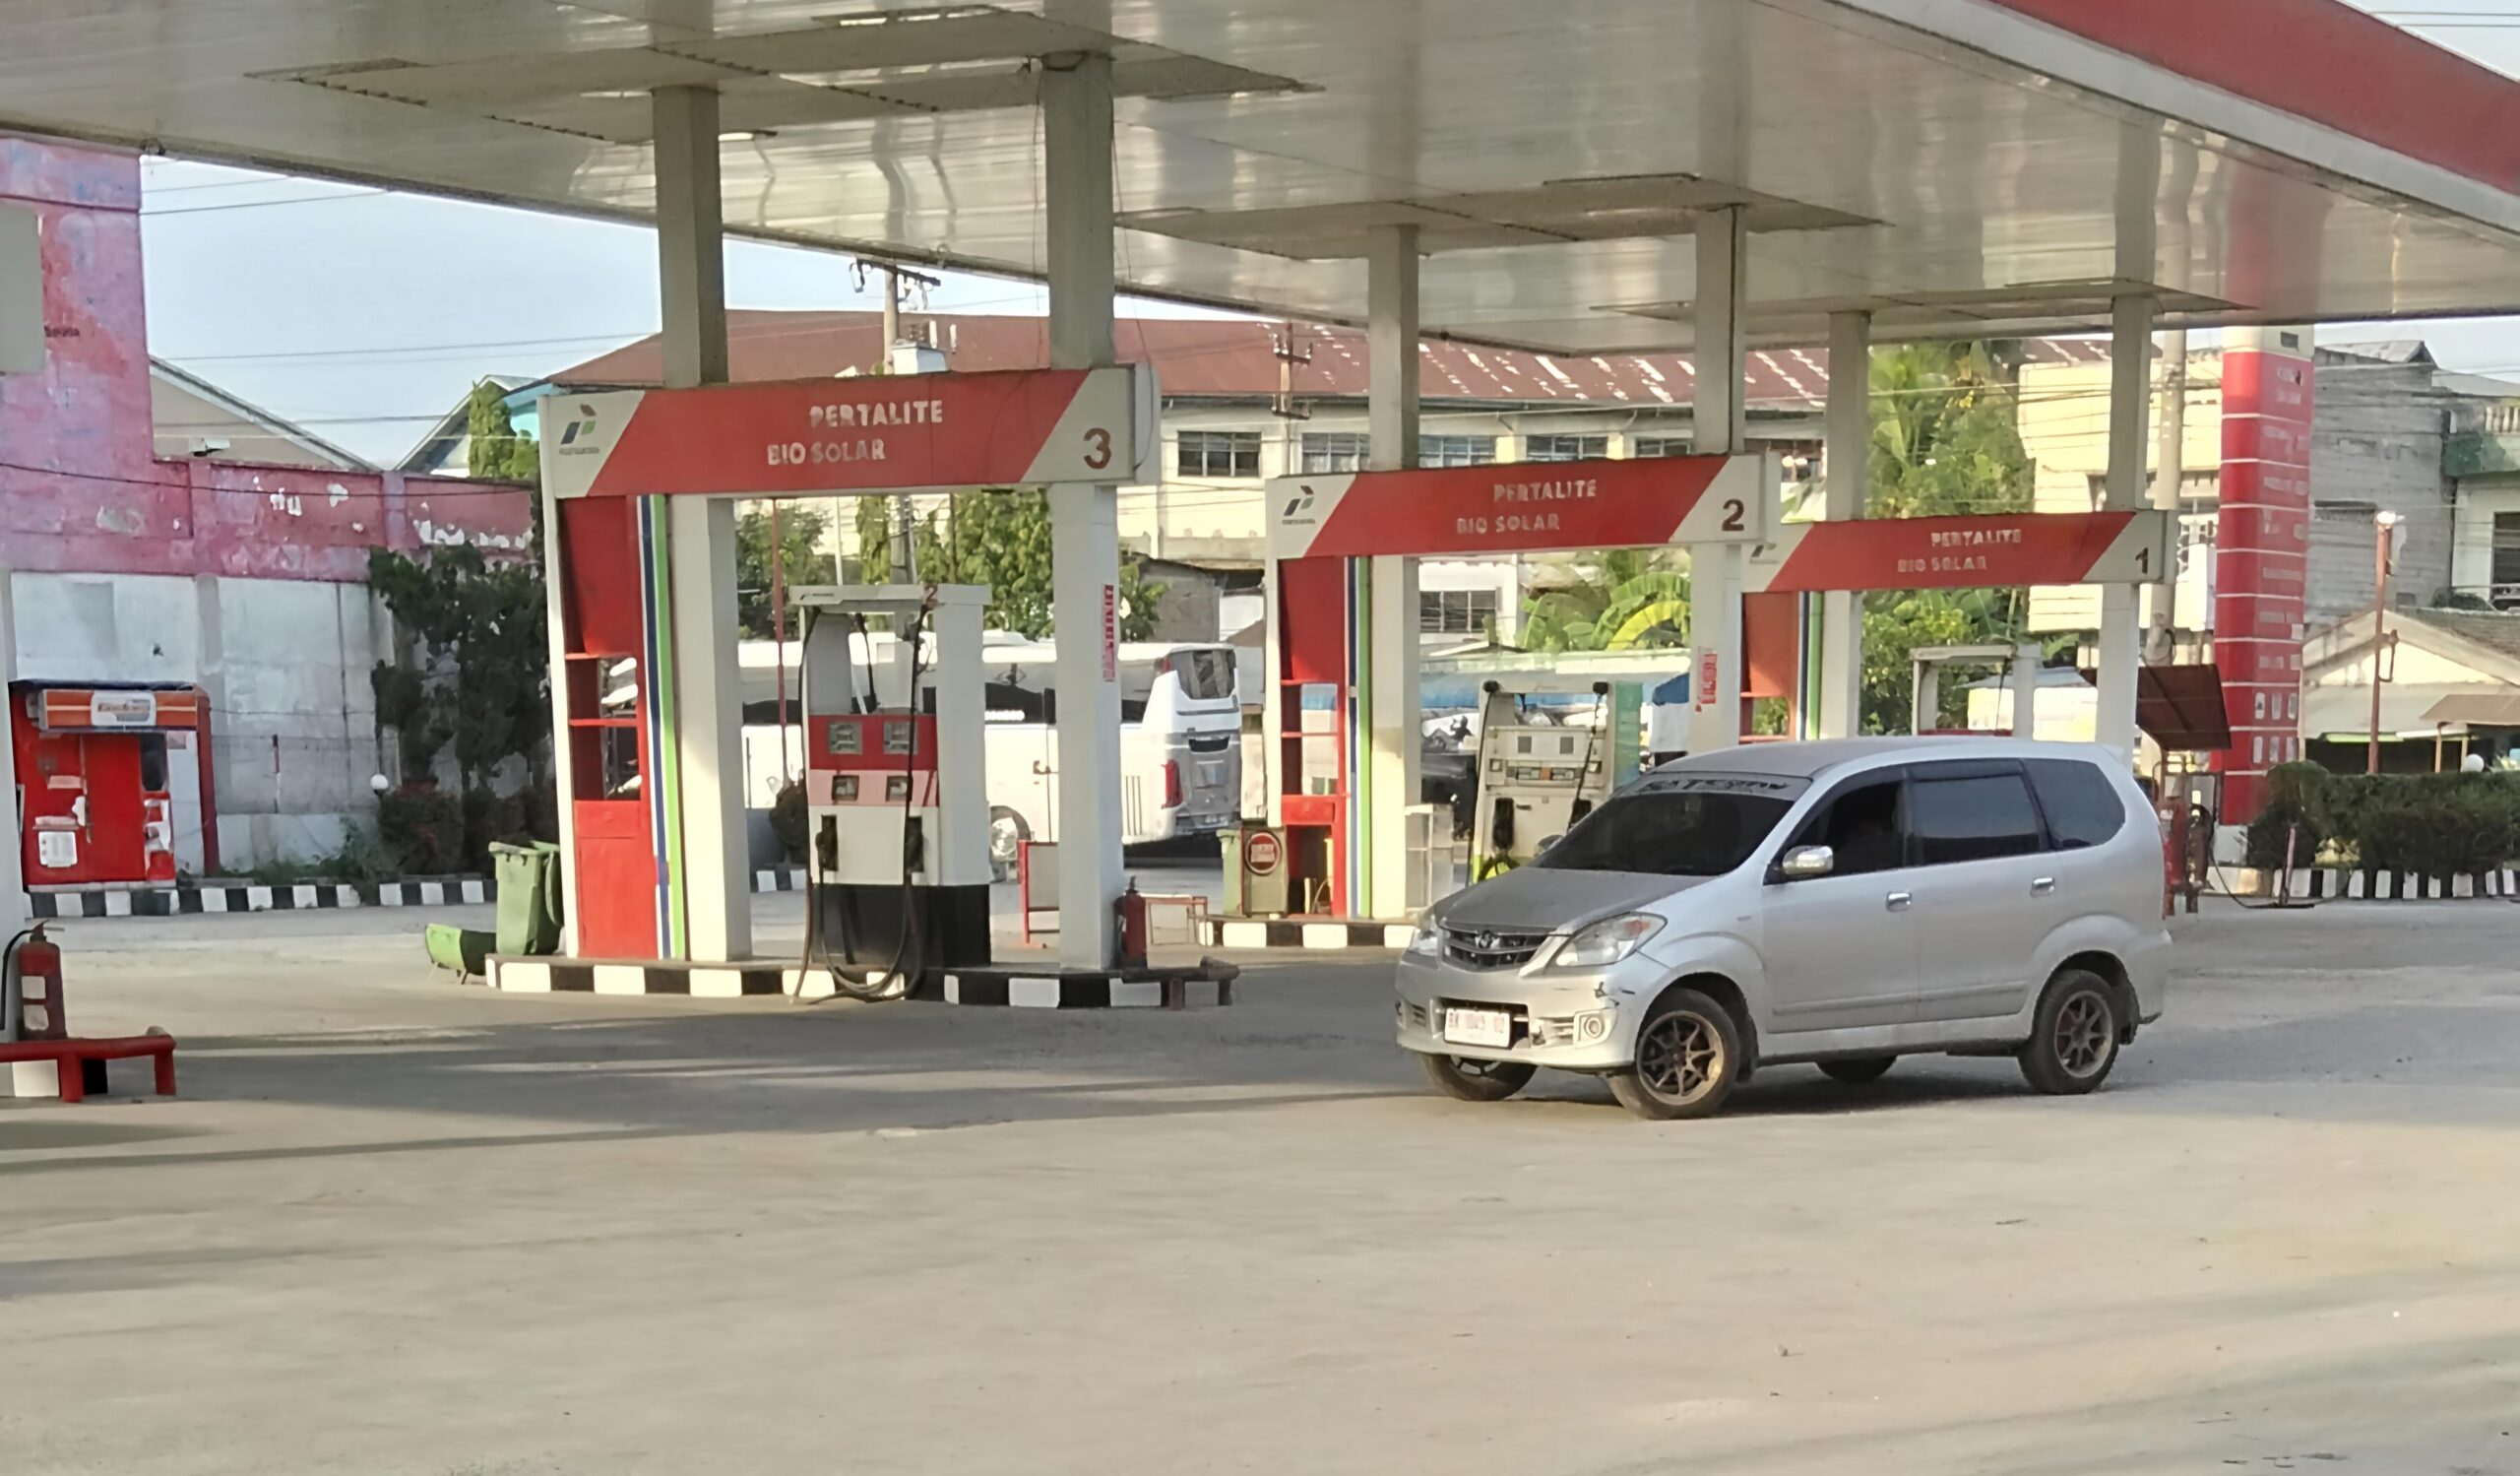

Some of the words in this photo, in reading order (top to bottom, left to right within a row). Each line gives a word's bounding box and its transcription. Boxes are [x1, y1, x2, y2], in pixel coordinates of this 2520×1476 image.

[809, 399, 943, 428] PERTALITE
[766, 441, 807, 466] BIO
[809, 438, 887, 465] SOLAR
[1083, 427, 1111, 470] 3
[1493, 479, 1597, 502] PERTALITE
[1456, 516, 1488, 535] BIO
[1494, 513, 1560, 534] SOLAR
[1722, 498, 1744, 532] 2
[1930, 528, 2022, 547] PERTALITE
[1930, 555, 1987, 572] SOLAR
[2134, 546, 2149, 575] 1
